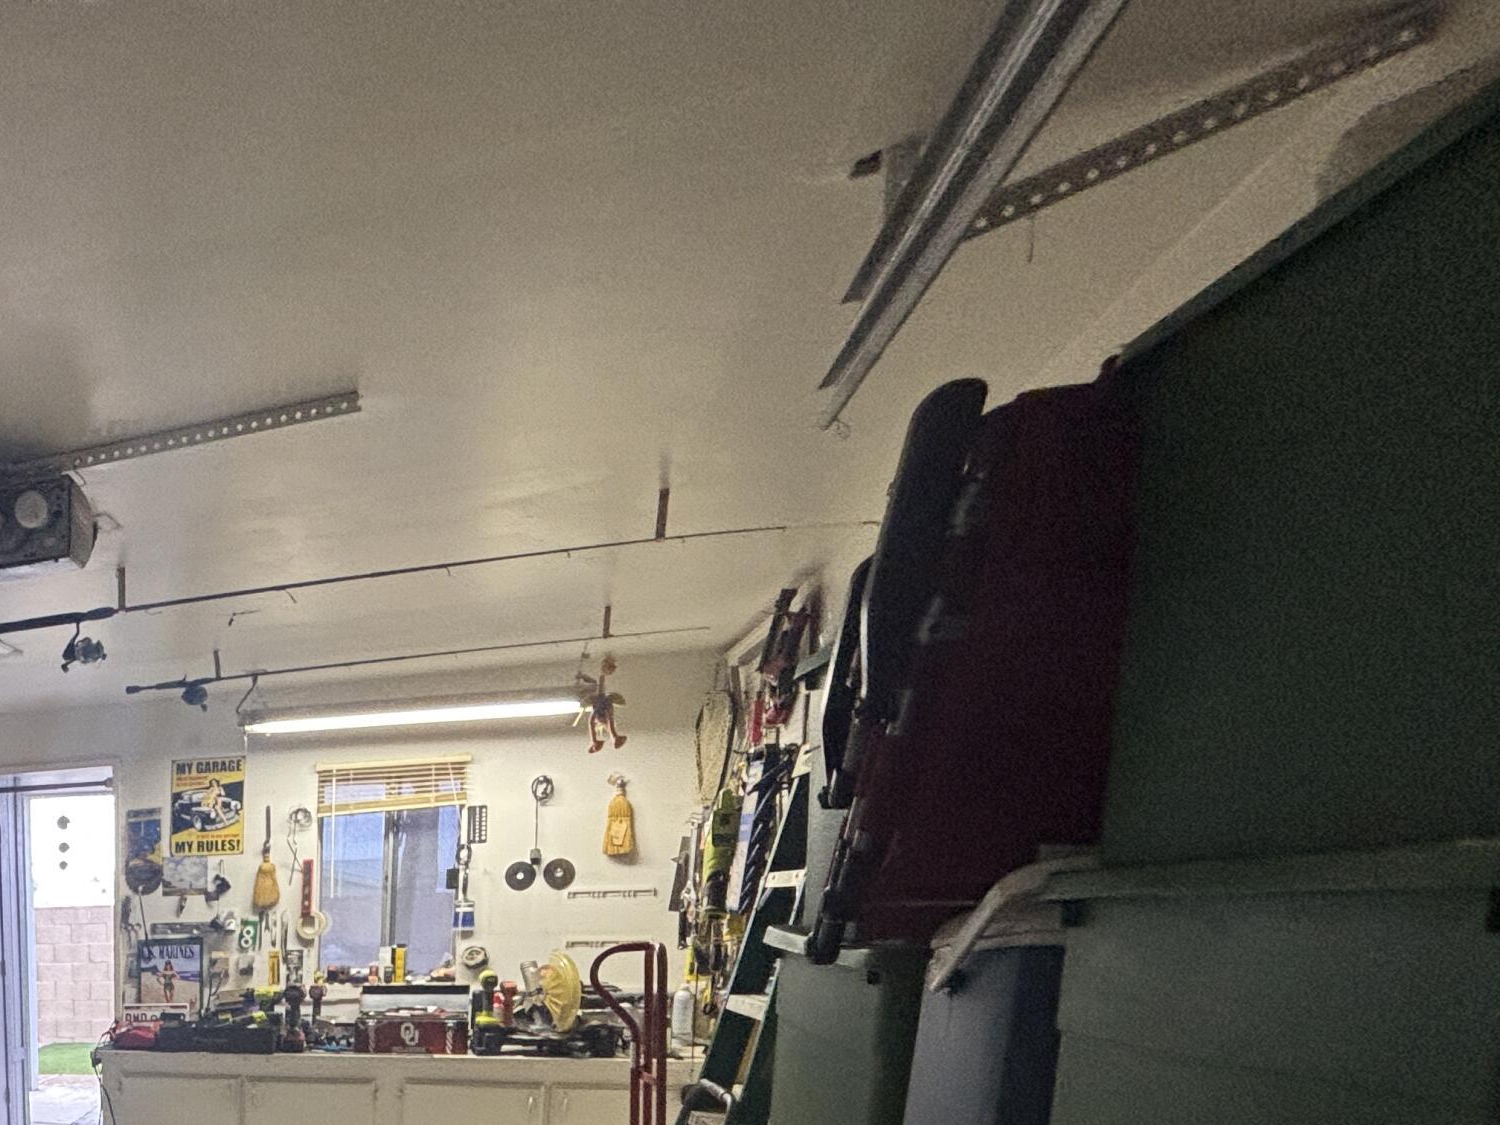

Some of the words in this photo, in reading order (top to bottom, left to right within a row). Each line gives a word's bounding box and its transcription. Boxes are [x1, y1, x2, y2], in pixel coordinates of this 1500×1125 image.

[176, 763, 193, 774] MY
[196, 760, 242, 773] GARAGE
[175, 841, 193, 853] MY
[197, 839, 240, 852] RULES!
[159, 945, 194, 959] MARINES
